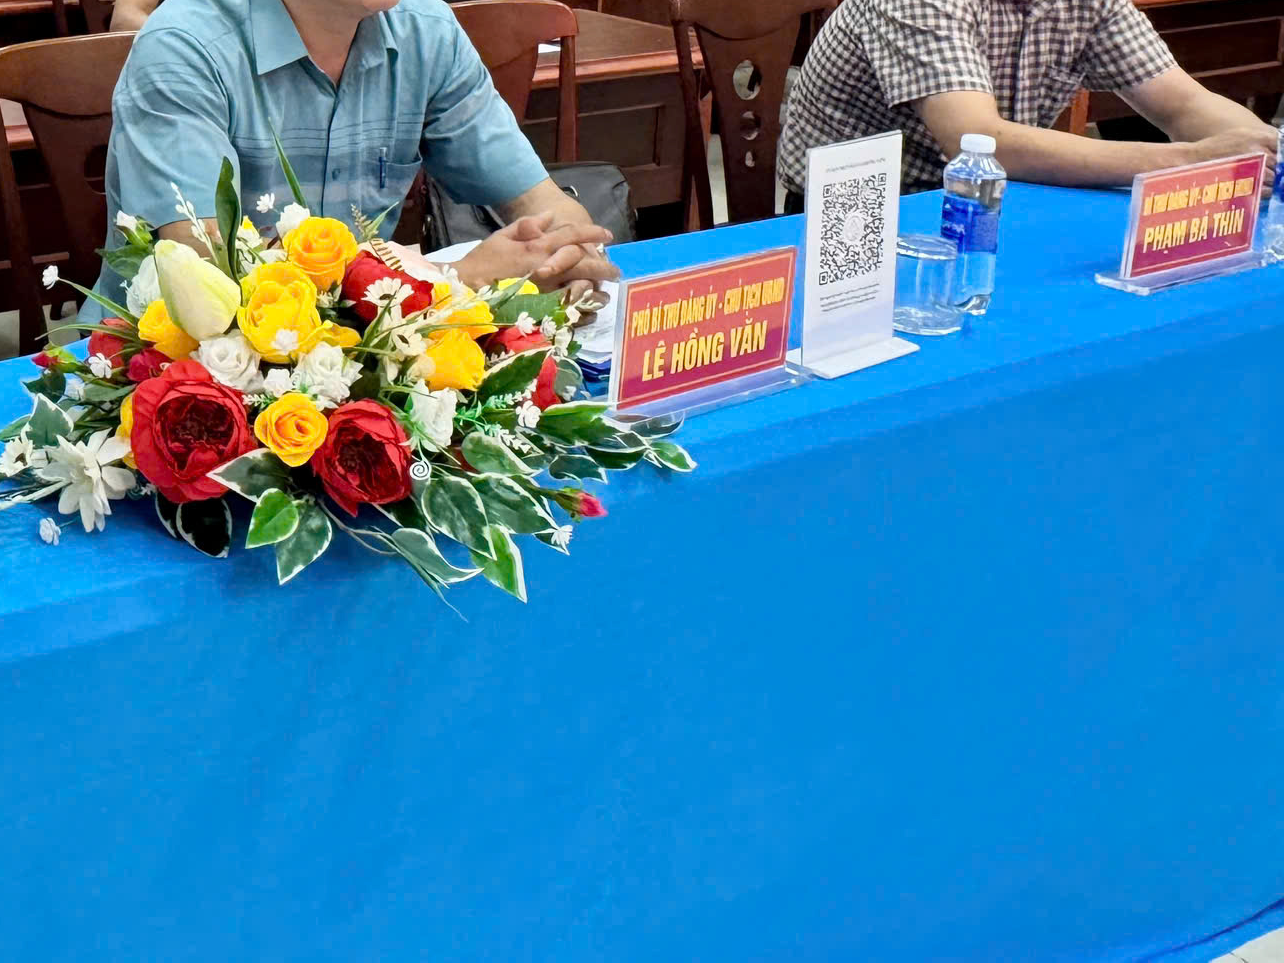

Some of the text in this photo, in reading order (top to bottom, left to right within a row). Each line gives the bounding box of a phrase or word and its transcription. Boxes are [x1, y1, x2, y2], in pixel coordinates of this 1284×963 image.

[1143, 220, 1188, 254] PHẠM
[631, 302, 651, 338] PHÓ
[642, 317, 768, 382] LÊ HỒNG VĂN
